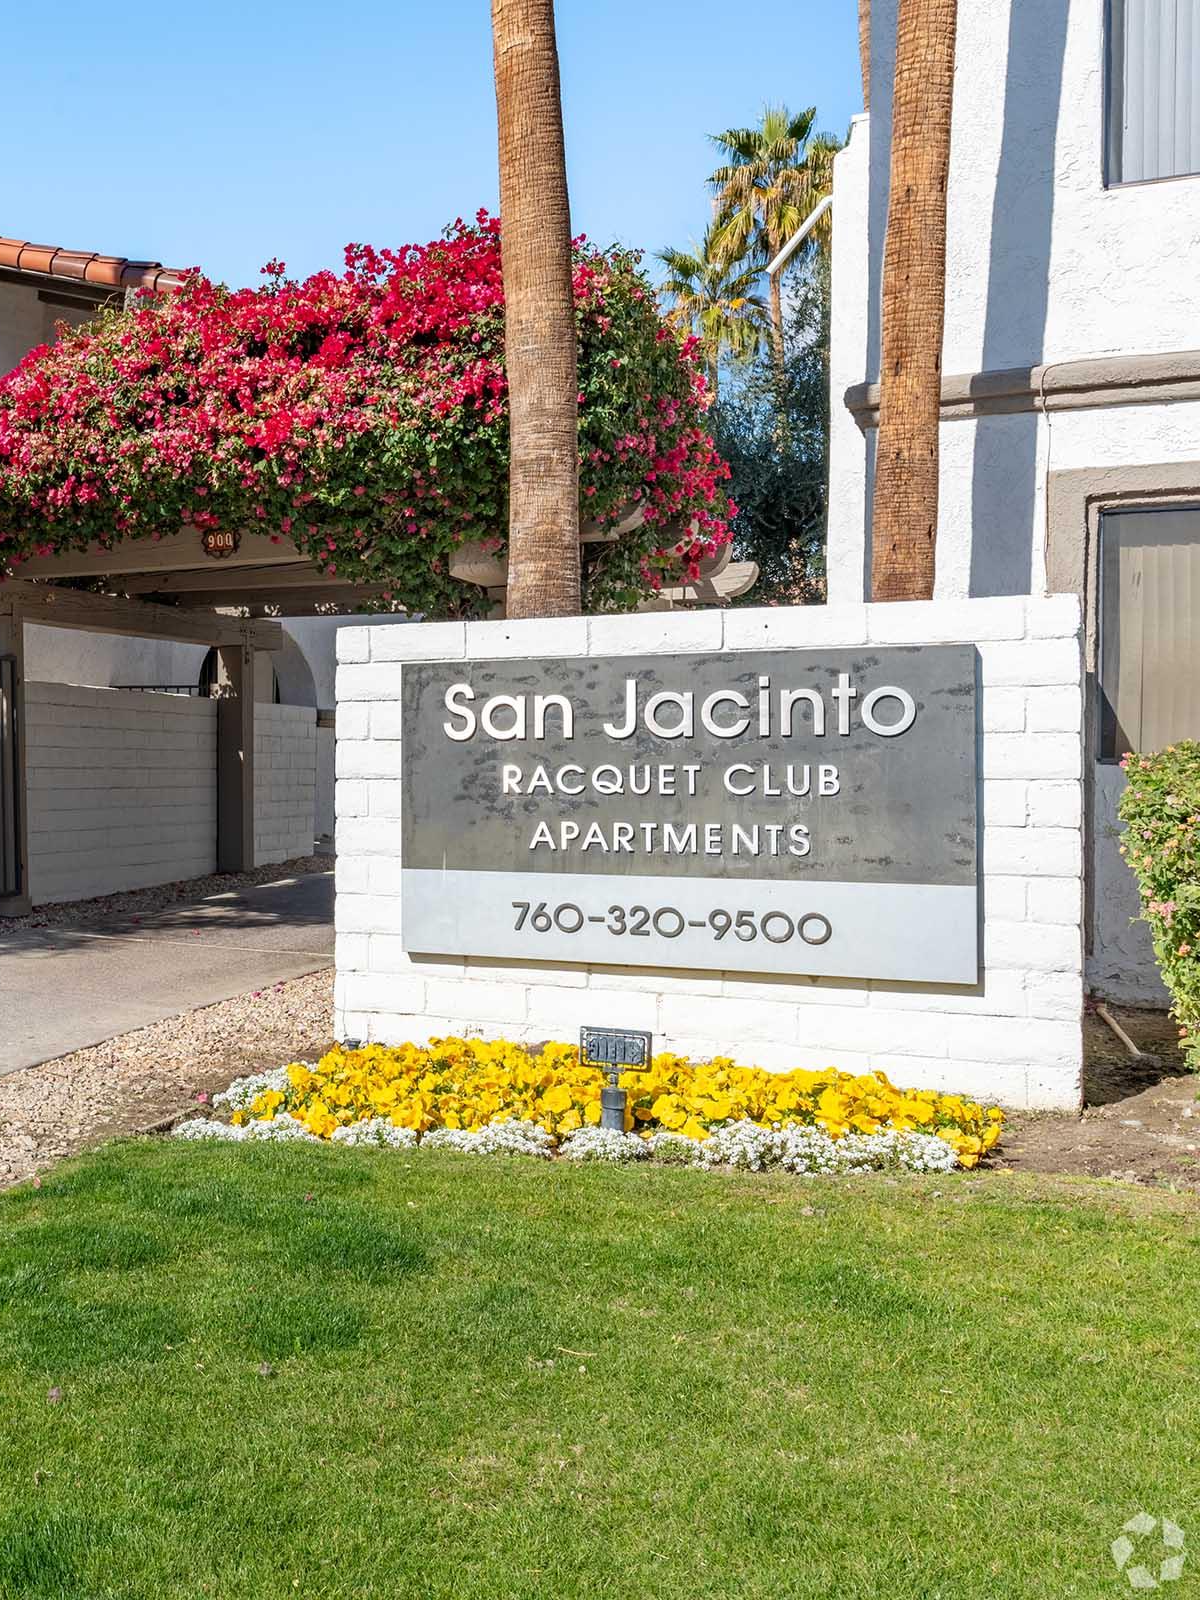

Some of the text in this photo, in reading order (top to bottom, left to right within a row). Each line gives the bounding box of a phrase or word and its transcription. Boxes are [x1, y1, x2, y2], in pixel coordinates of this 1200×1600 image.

[208, 533, 233, 548] 900
[443, 673, 916, 742] San Jacinto
[503, 763, 841, 797] RACQUET CLUB
[530, 821, 811, 856] APARTMENTS
[512, 902, 832, 945] 760-320-9500
